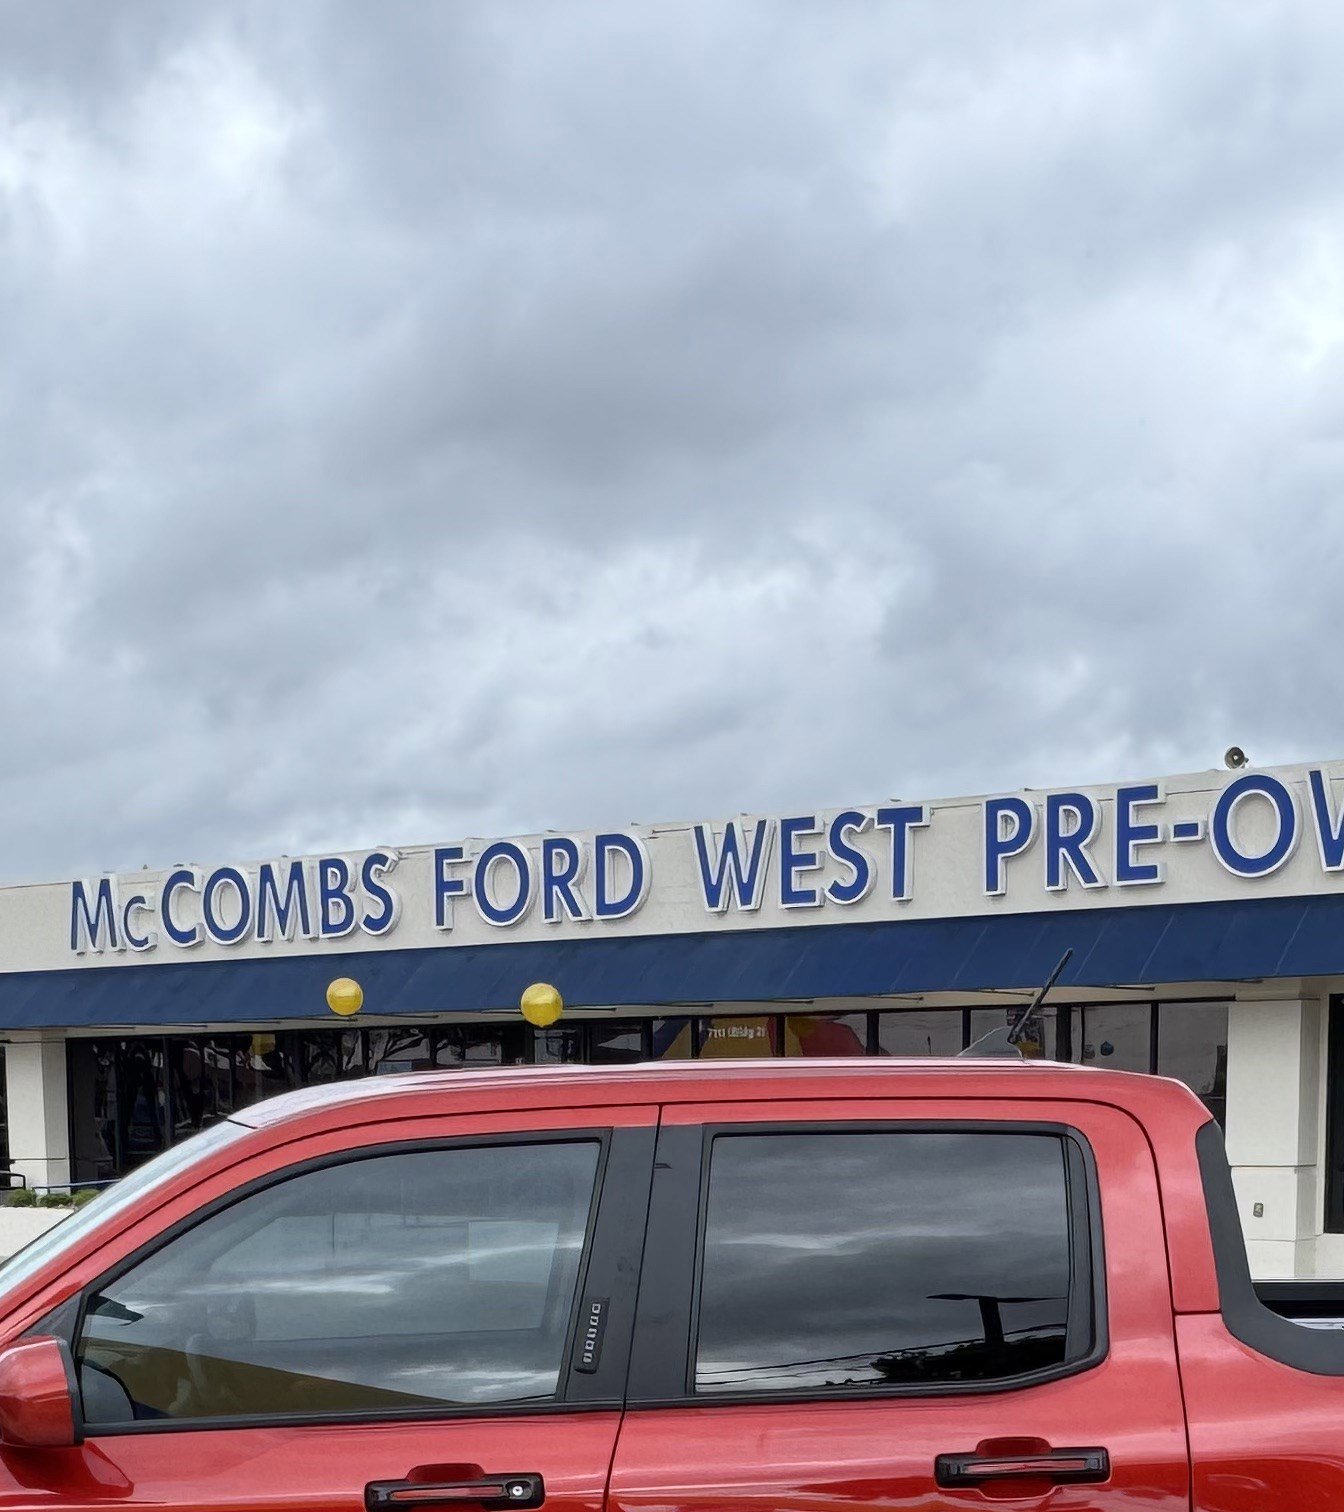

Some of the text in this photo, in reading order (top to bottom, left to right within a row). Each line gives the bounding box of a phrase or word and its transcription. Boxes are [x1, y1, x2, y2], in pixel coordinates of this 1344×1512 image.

[69, 851, 398, 953] McCOMBS
[433, 832, 648, 930] FORD
[693, 804, 926, 913] WEST
